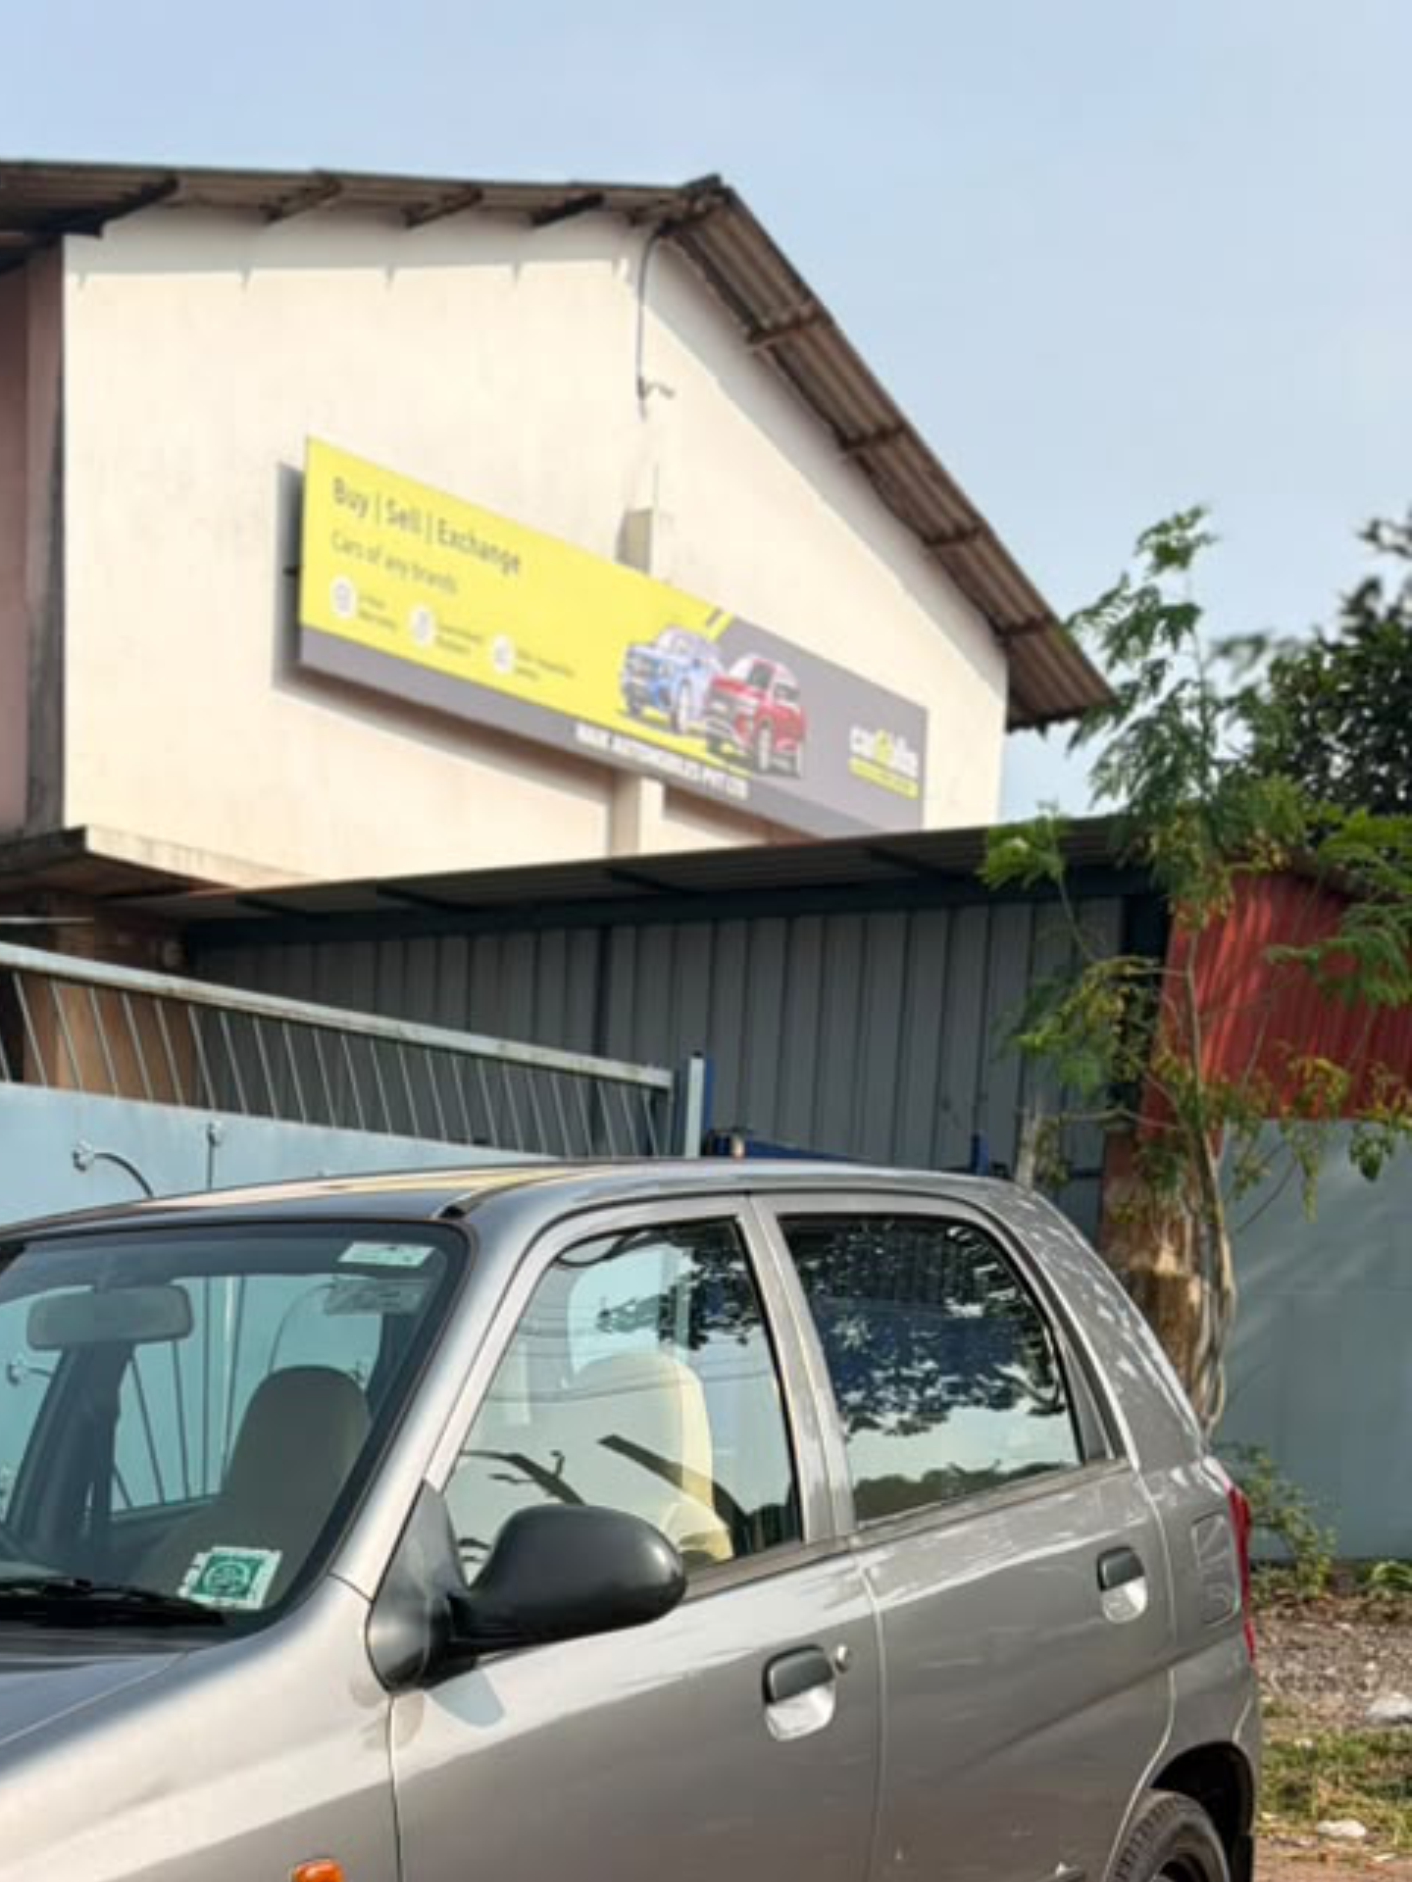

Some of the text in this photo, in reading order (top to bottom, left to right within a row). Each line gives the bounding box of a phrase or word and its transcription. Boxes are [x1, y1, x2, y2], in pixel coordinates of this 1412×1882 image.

[331, 529, 364, 560] Cars
[366, 543, 384, 565] of
[385, 555, 408, 580] any
[332, 476, 369, 519] Buy
[387, 499, 422, 534] Sell
[437, 517, 520, 576] Exchange
